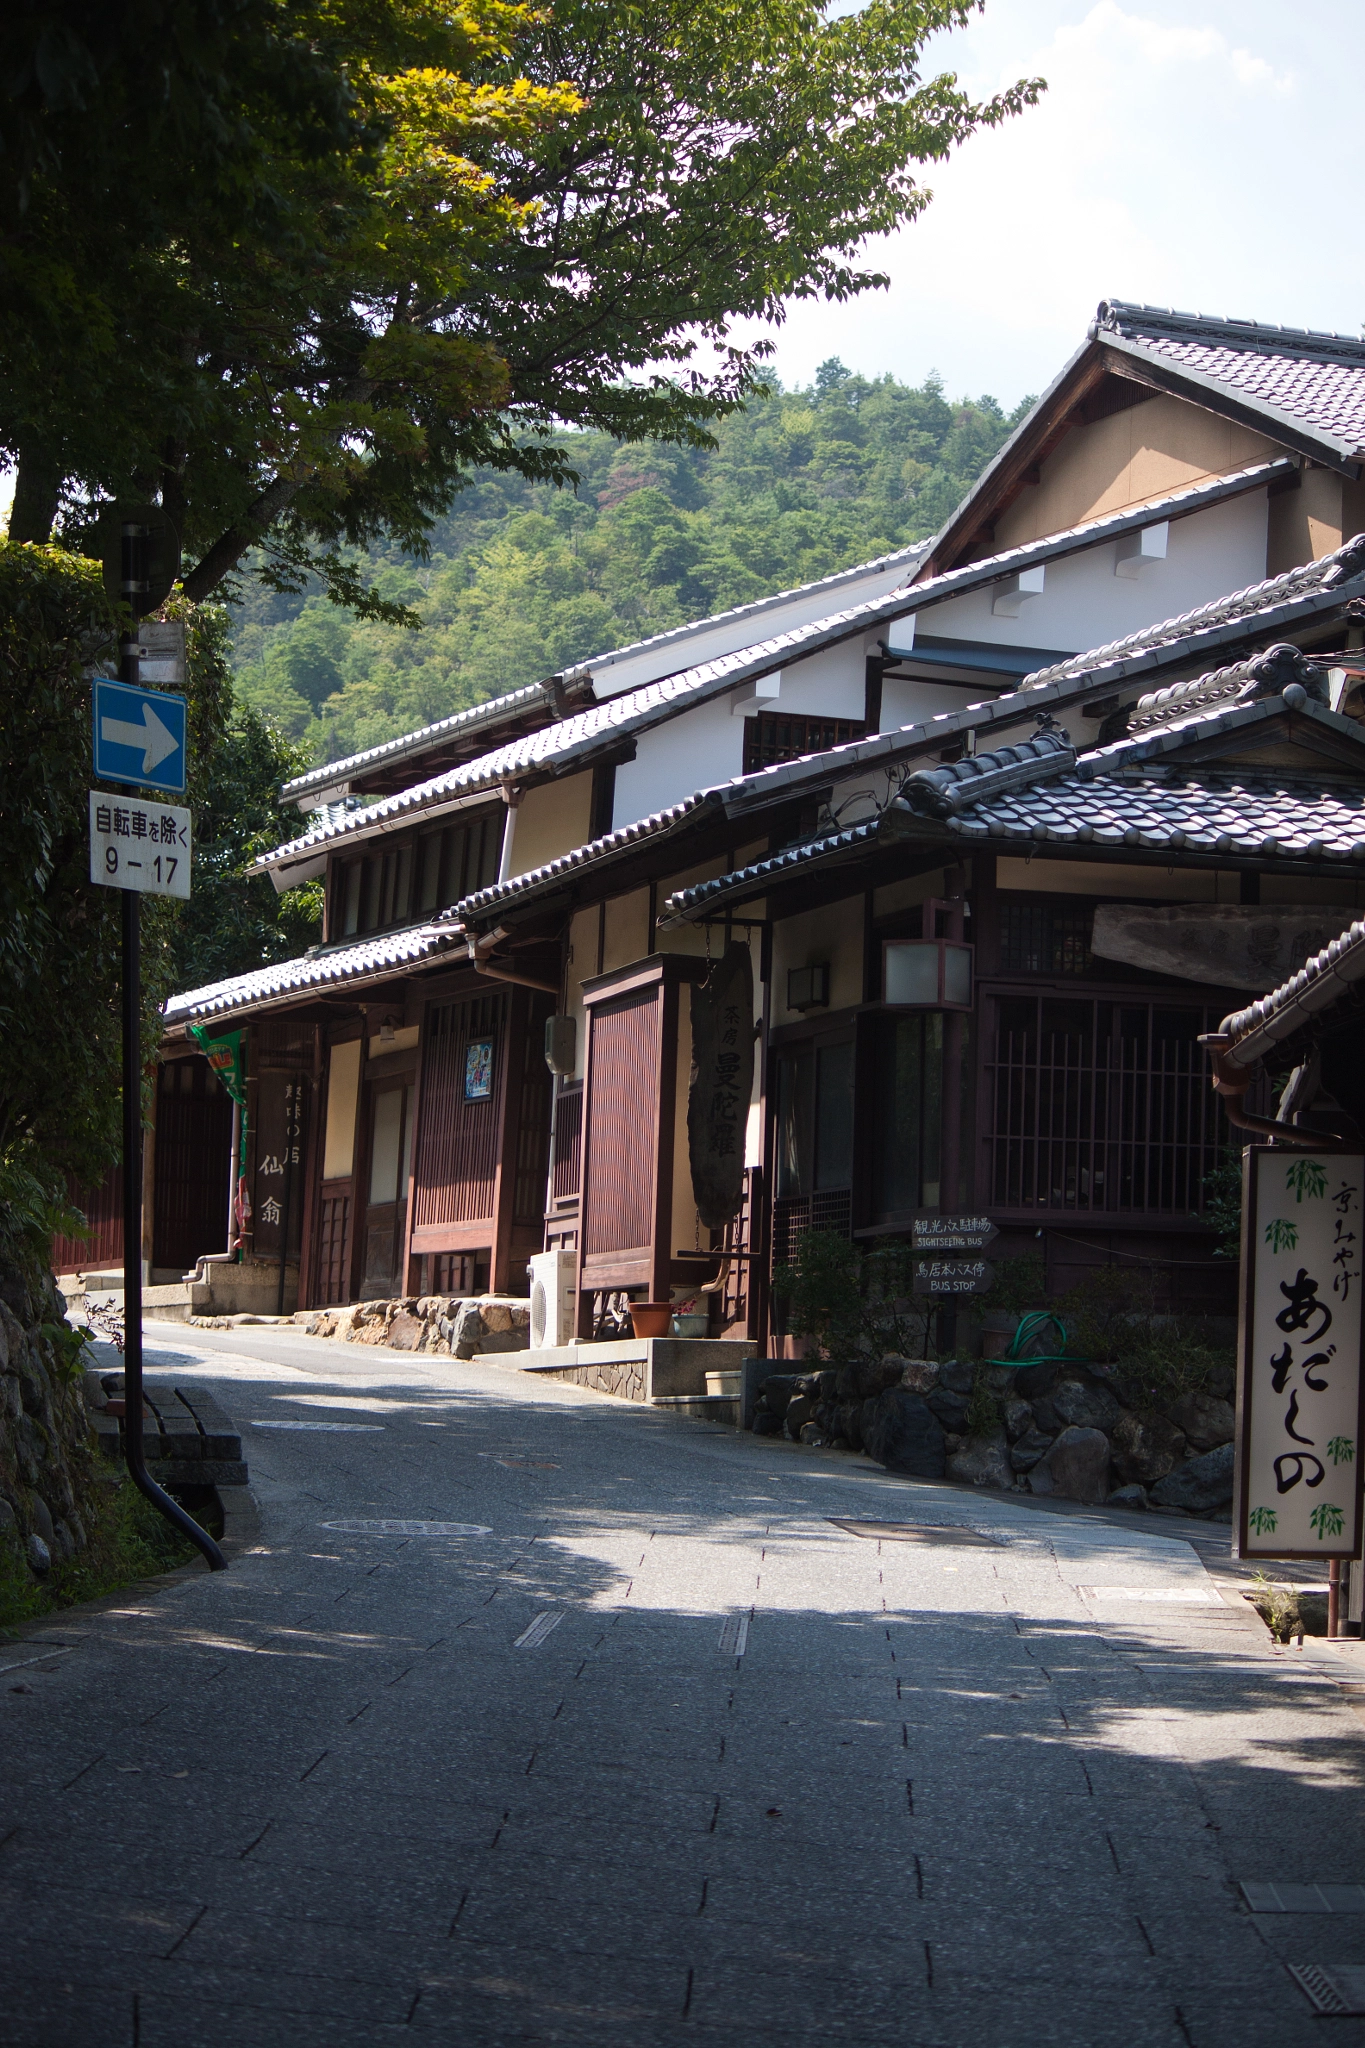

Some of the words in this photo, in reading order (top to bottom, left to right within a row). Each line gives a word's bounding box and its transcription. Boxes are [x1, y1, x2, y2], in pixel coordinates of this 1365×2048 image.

[97, 804, 188, 848] 自転車を除く
[258, 1154, 284, 1226] 仙翁
[913, 1217, 992, 1235] 観光バス駐車場
[1331, 1180, 1361, 1302] 京みやげ
[917, 1237, 966, 1247] SIGHTSEEING
[967, 1237, 983, 1246] BUS
[915, 1261, 986, 1278] 鳥居本バス停
[930, 1280, 951, 1291] BUS
[953, 1280, 976, 1291] STOP
[1270, 1267, 1337, 1494] あだしの
